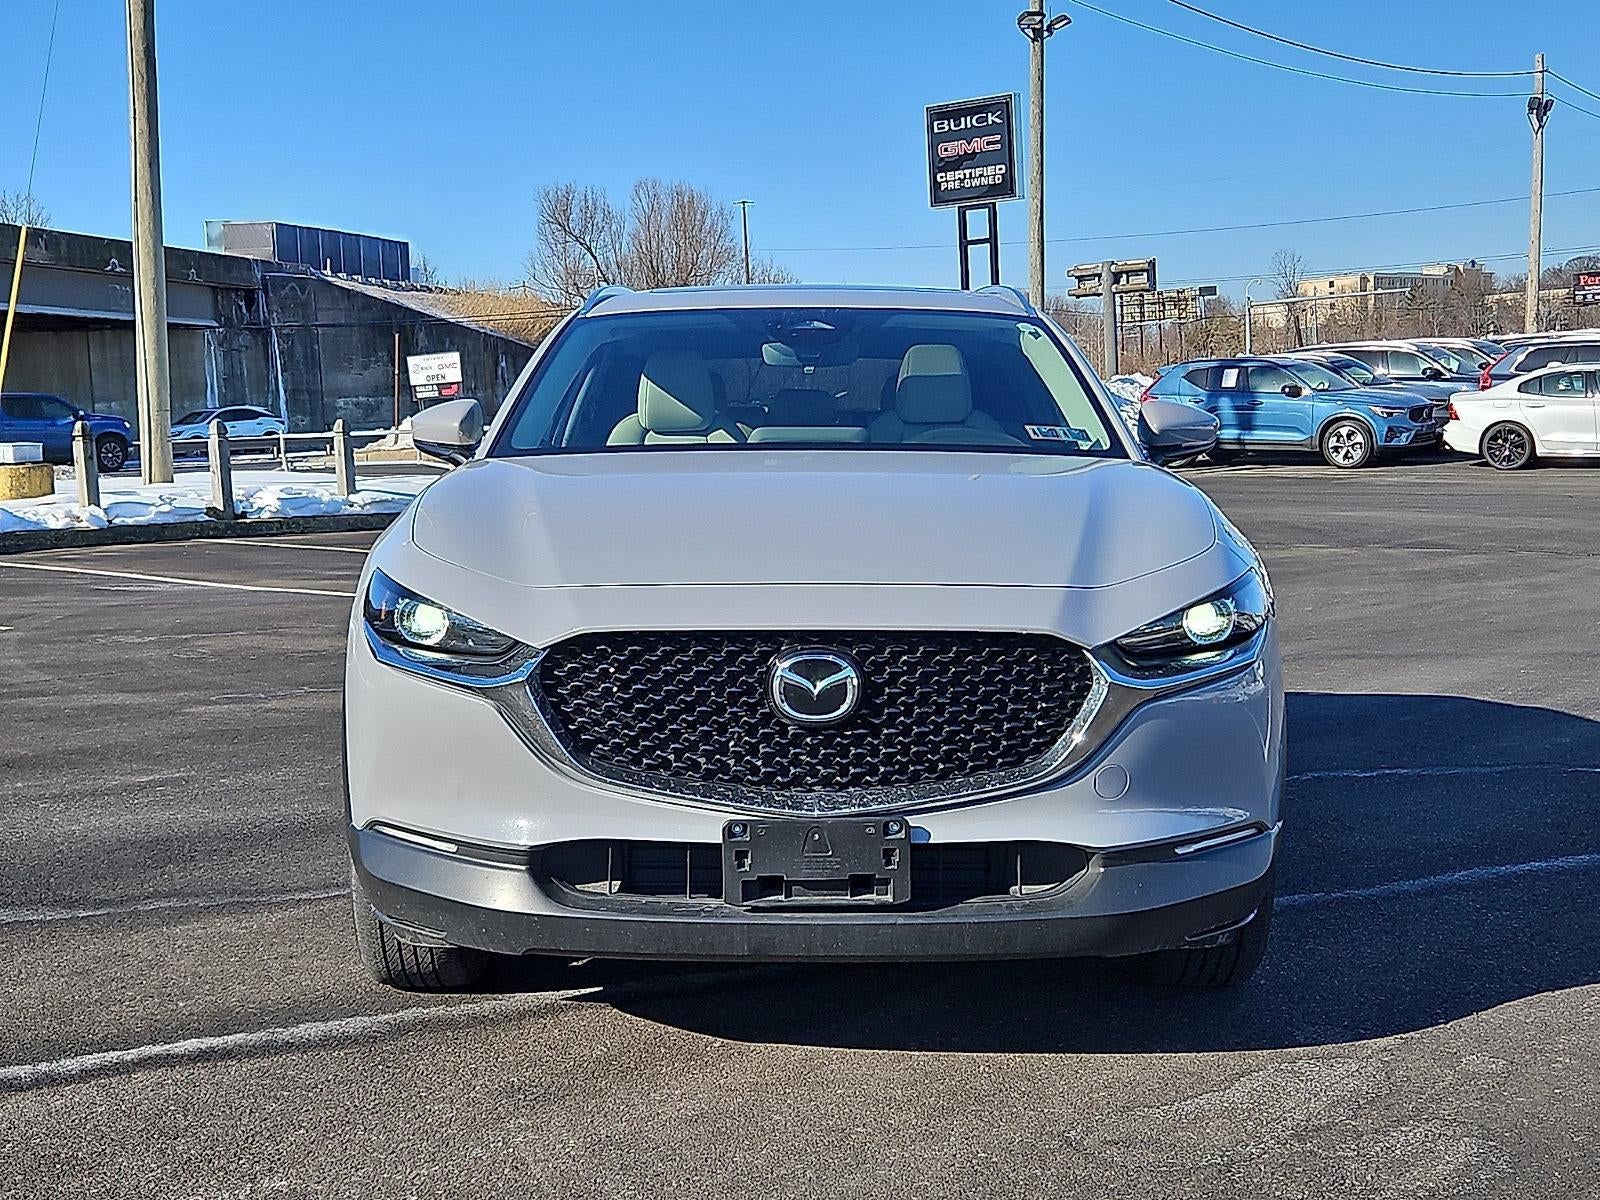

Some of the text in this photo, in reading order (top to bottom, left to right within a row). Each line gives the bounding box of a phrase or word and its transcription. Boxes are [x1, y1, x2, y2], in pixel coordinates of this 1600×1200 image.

[933, 110, 1003, 133] BUICK
[938, 134, 1002, 158] GMC
[936, 164, 1006, 183] CERTIFIED
[940, 174, 1003, 191] PRE-OWNED
[437, 362, 458, 370] GMC
[425, 373, 446, 382] OPEN
